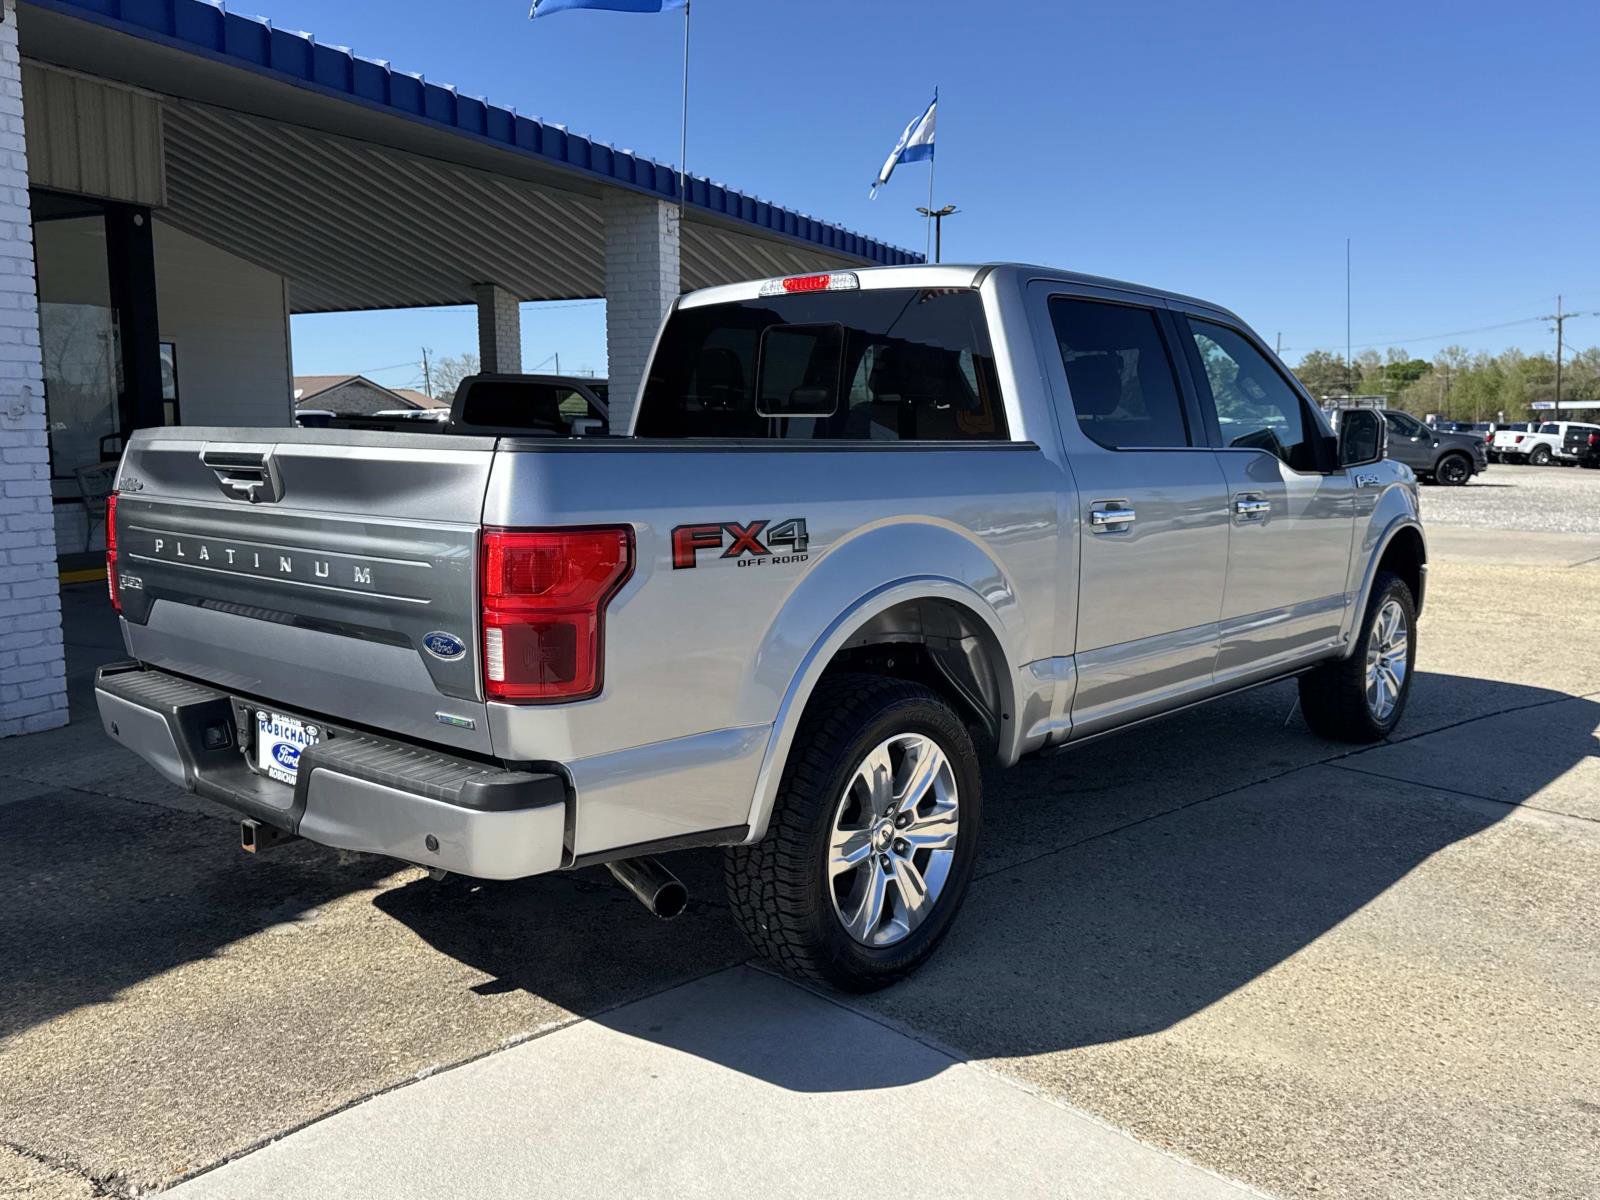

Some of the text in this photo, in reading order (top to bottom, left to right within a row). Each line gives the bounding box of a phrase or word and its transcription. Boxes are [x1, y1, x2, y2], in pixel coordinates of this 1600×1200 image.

[671, 517, 809, 570] FX4
[154, 537, 373, 585] PLATINUM
[737, 554, 809, 568] OFF ROAD
[429, 636, 454, 656] Ford
